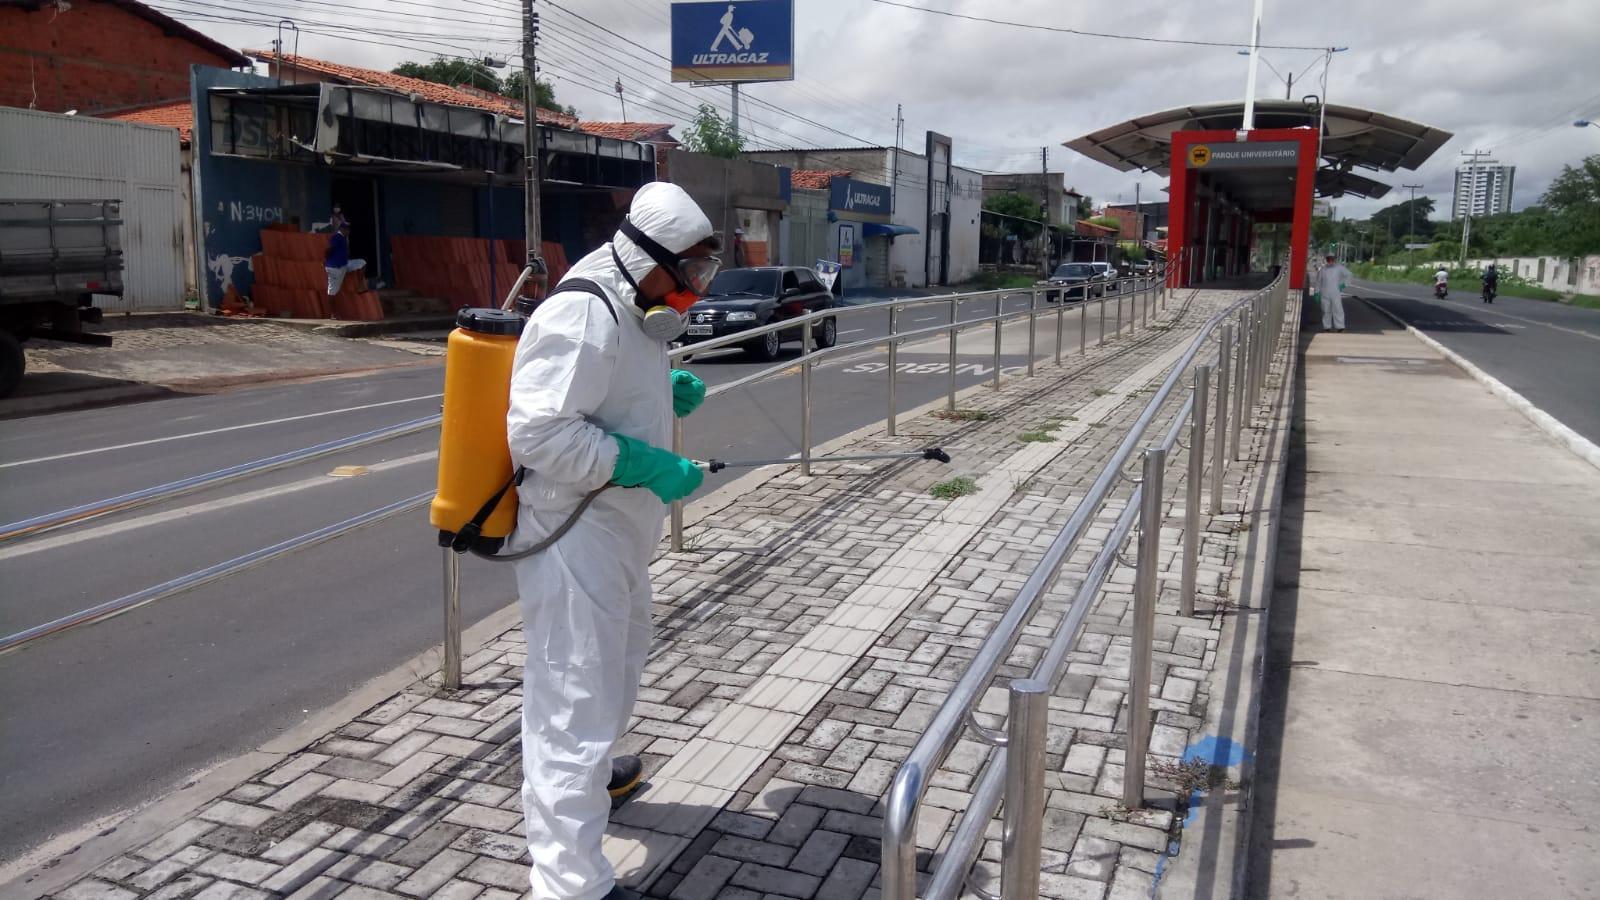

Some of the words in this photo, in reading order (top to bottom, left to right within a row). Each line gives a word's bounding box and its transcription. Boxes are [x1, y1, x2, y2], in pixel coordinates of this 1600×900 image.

[692, 52, 769, 65] ULTRAGAZ
[1211, 151, 1240, 160] PARQUE
[1241, 149, 1296, 159] UNIVERSITÁRIO
[854, 192, 880, 207] ULTRAGAZ
